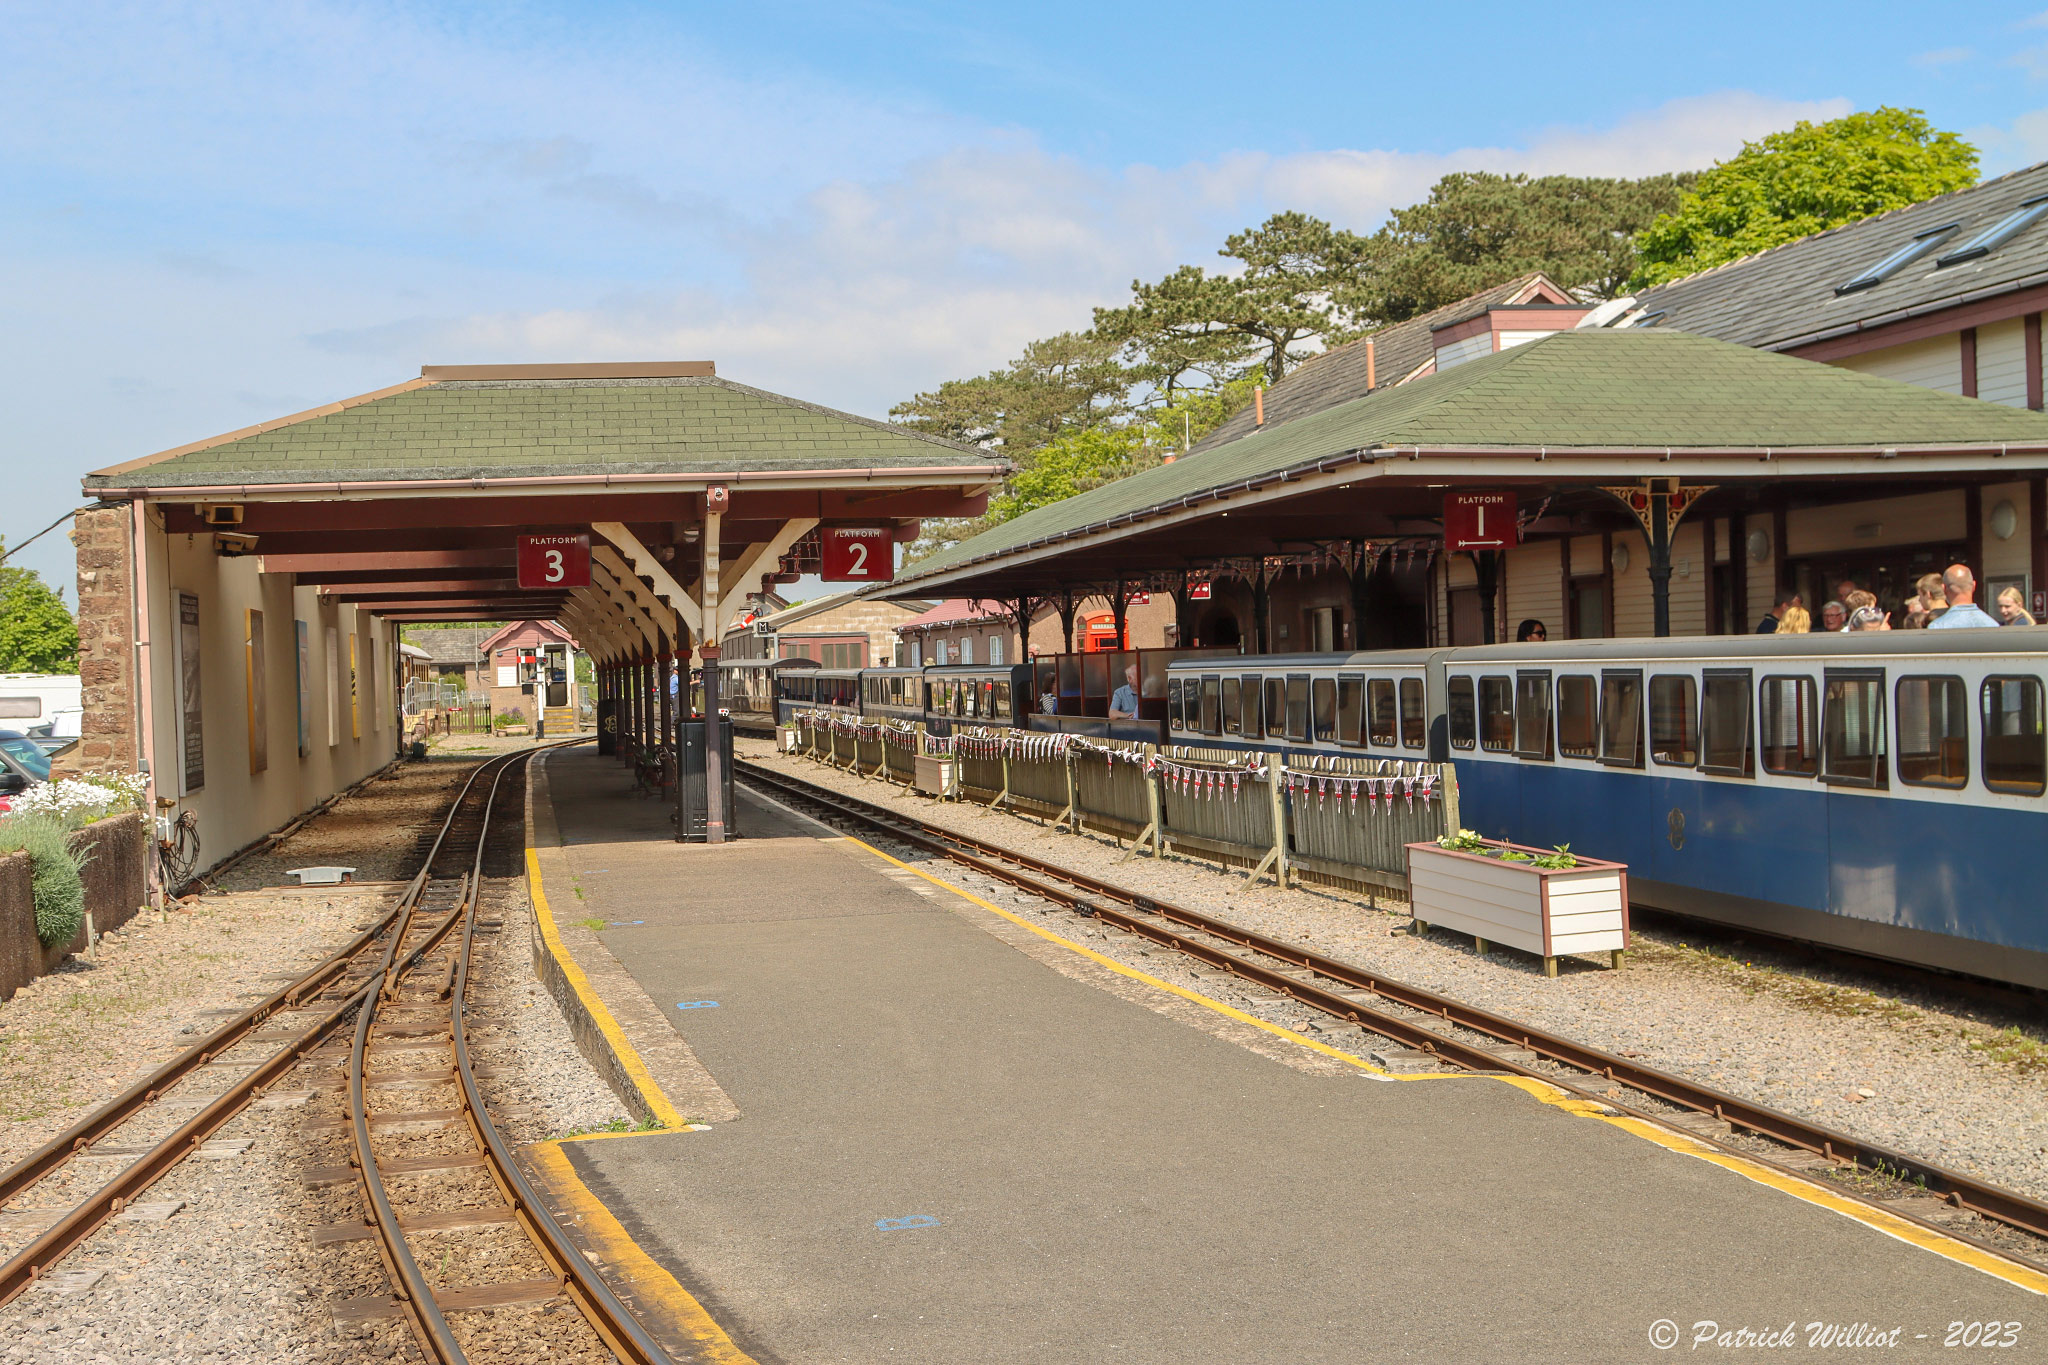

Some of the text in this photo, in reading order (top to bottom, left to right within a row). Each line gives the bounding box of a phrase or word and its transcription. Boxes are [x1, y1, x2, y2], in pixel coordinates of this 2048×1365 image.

[1458, 496, 1504, 504] PLATFORM
[834, 530, 880, 538] PLATFORM
[530, 537, 577, 545] PLATFORM
[847, 542, 868, 575] 2
[545, 549, 565, 582] 3
